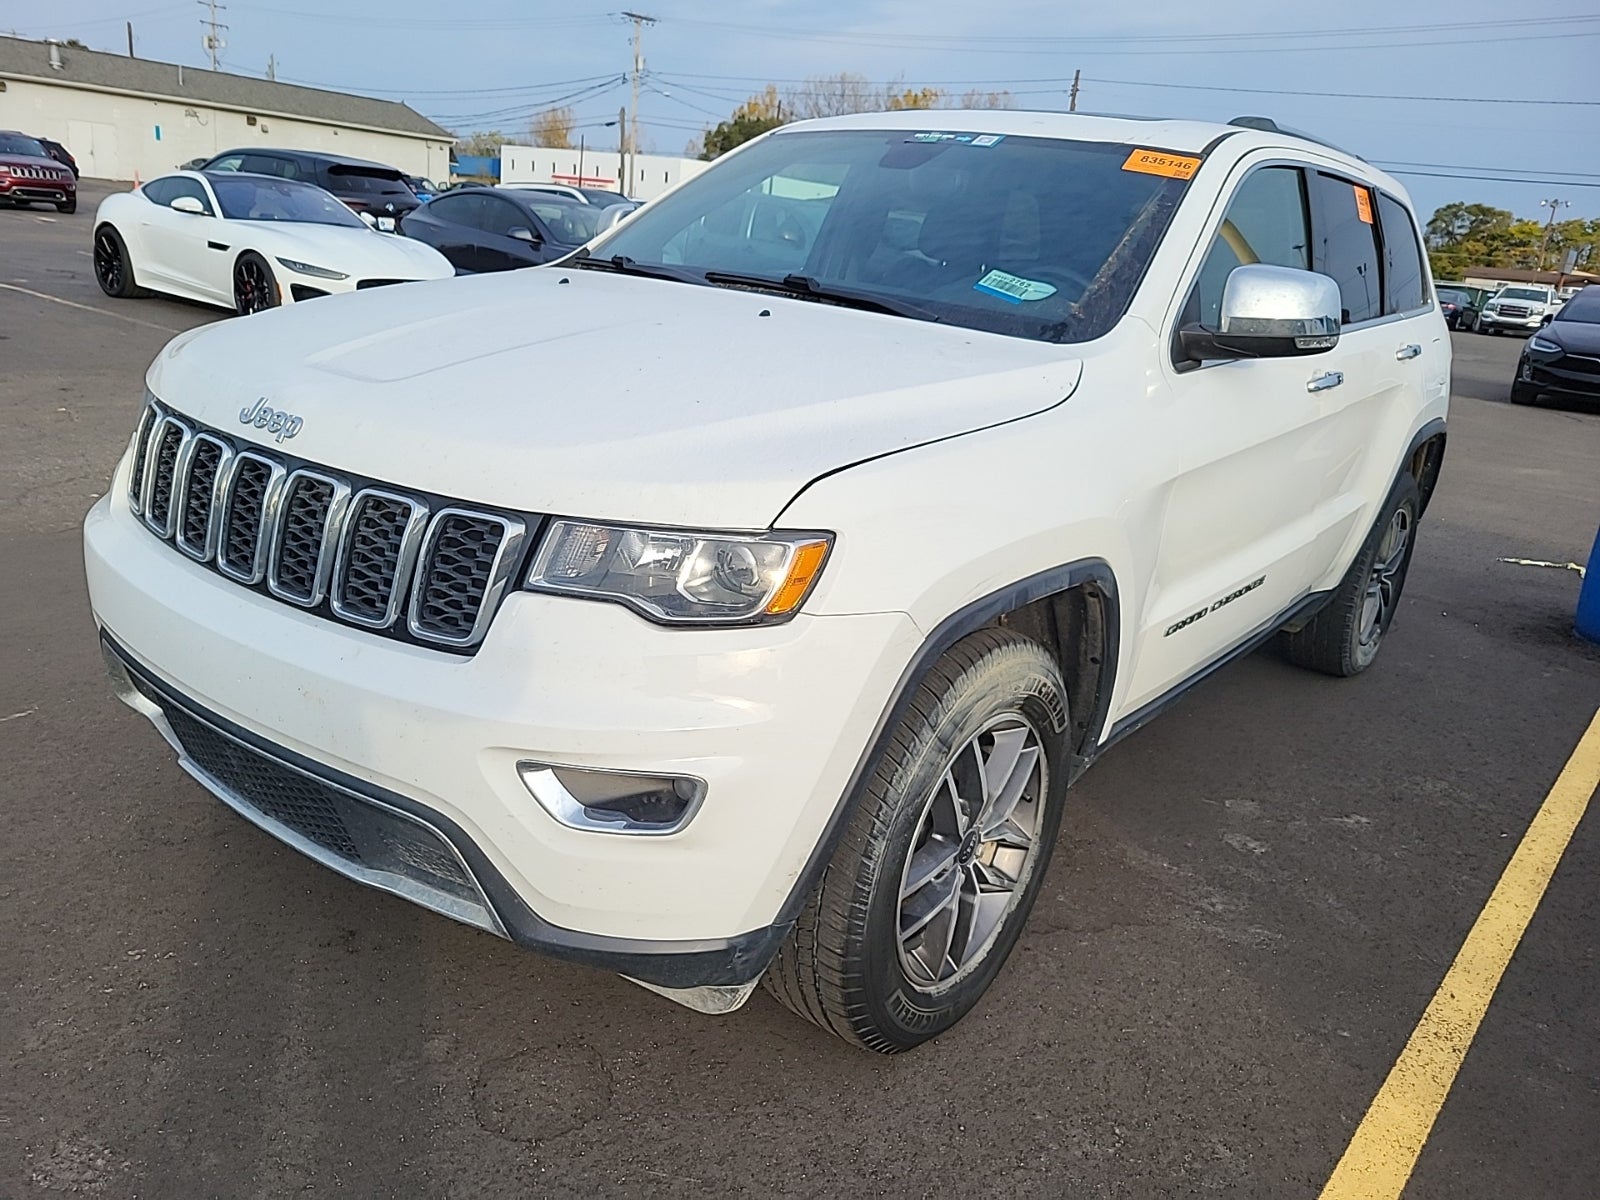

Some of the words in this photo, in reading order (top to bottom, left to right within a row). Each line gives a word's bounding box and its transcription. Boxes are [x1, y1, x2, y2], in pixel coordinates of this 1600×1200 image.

[1140, 155, 1192, 170] 835146
[240, 396, 304, 444] Jeep
[1163, 607, 1208, 638] GRAND
[1209, 574, 1267, 613] CHEROKEE
[1022, 675, 1067, 730] MICHELIN
